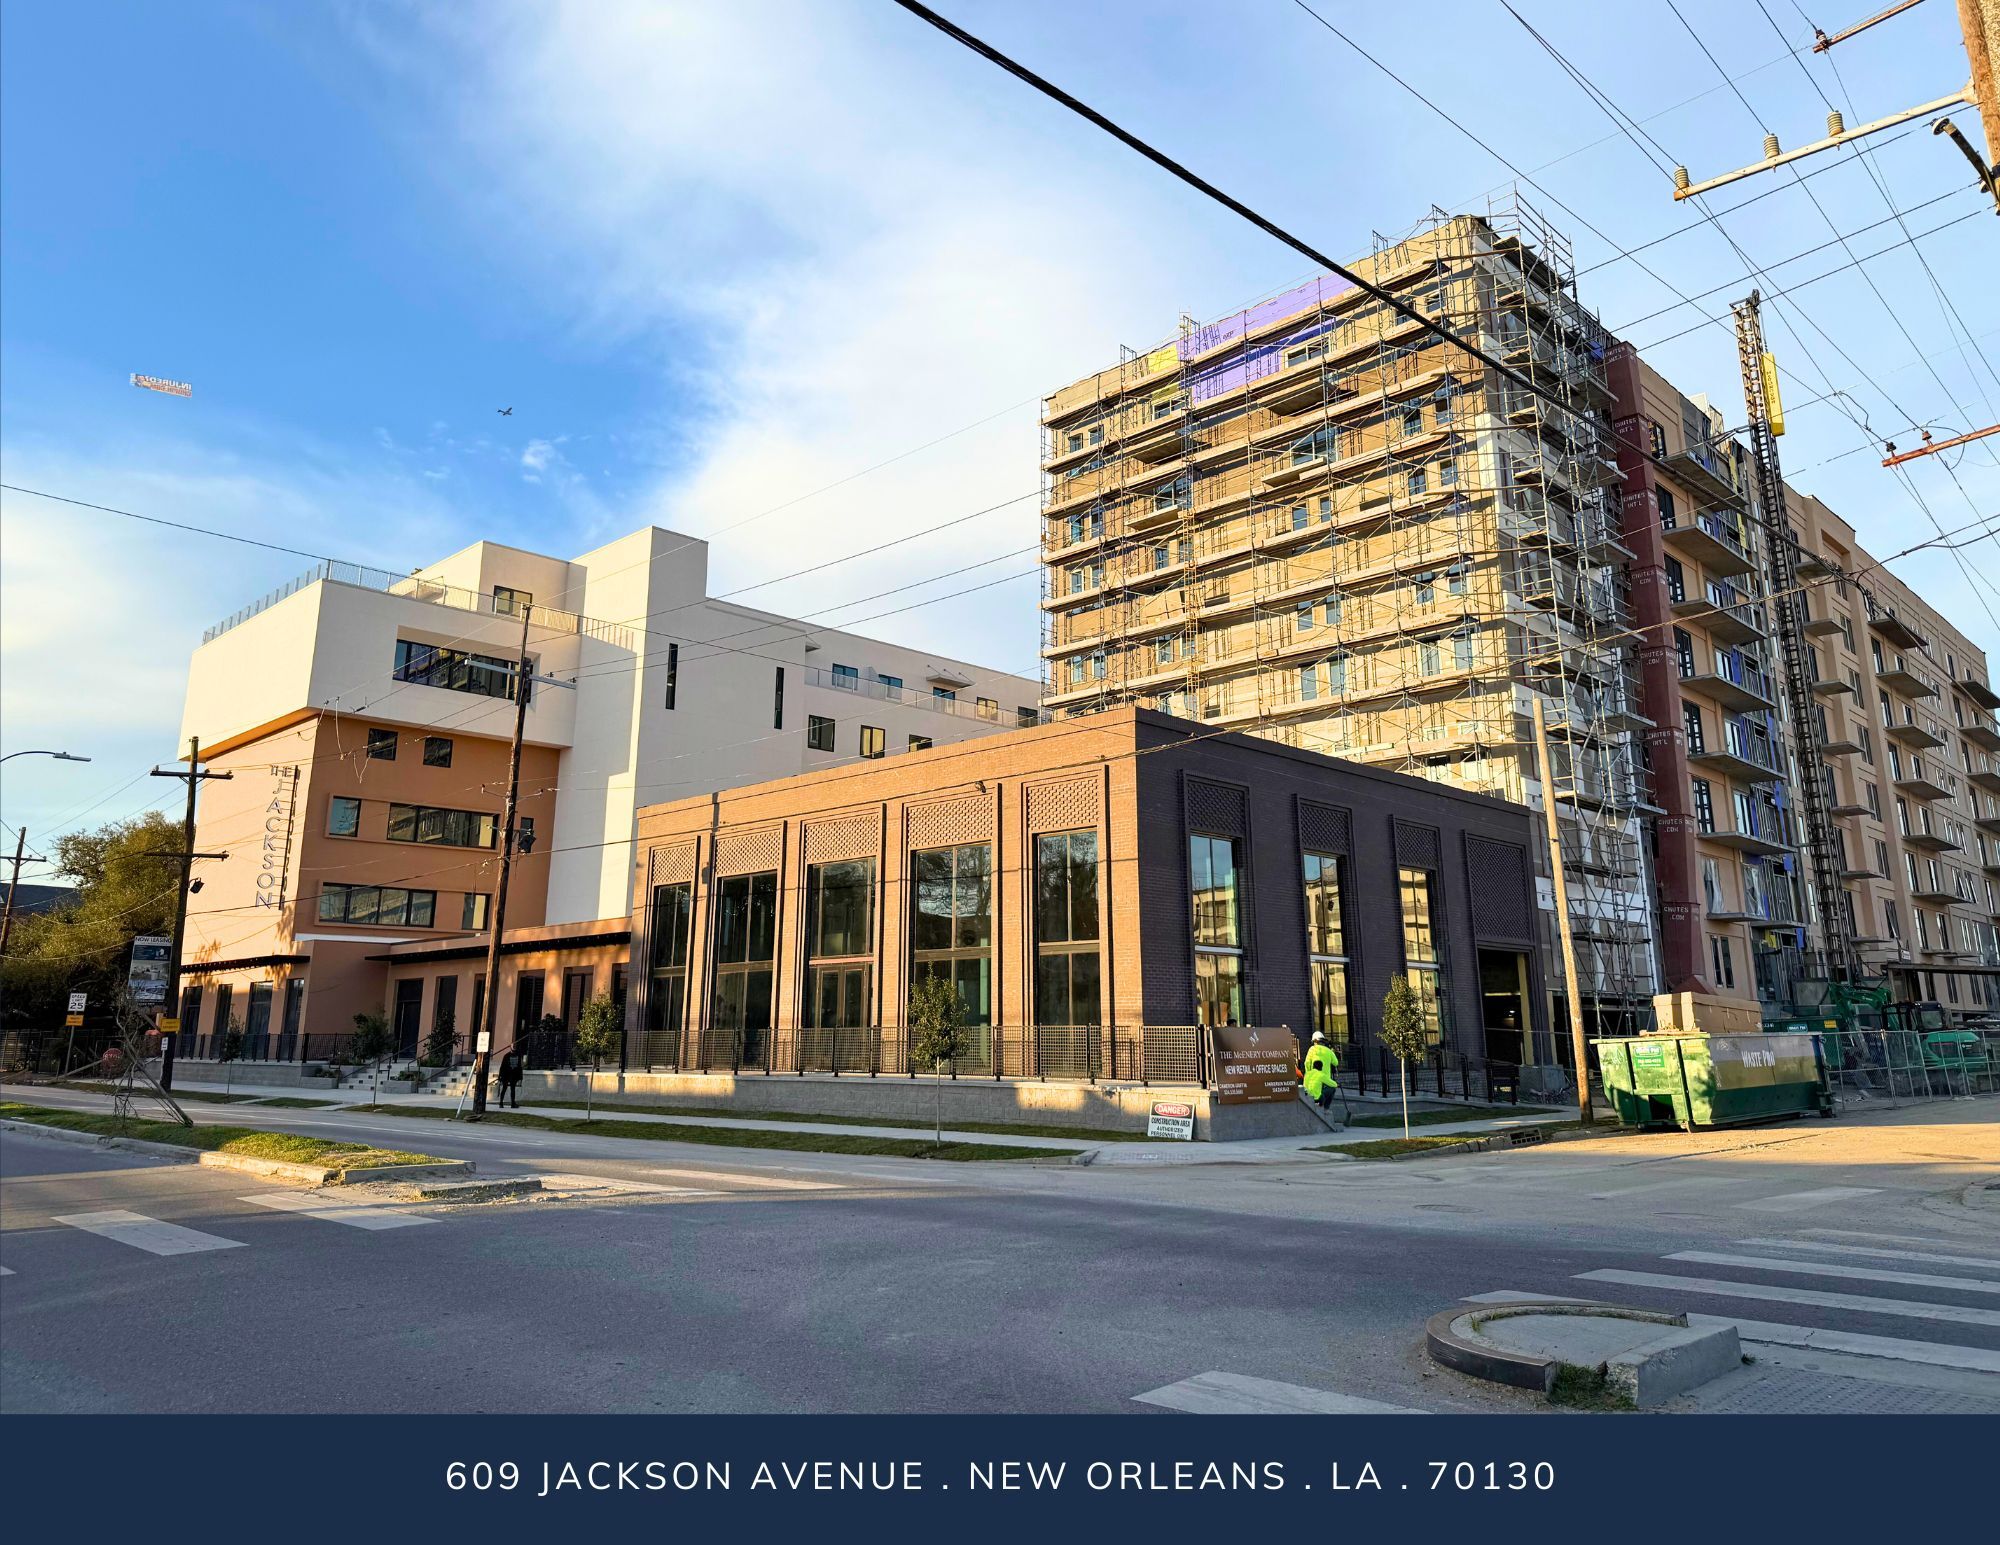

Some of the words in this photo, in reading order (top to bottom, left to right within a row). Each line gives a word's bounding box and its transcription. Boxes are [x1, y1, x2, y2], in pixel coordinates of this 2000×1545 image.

[1615, 417, 1637, 428] CHUTES
[1624, 492, 1645, 502] CHUTES
[1640, 650, 1663, 659] CHUTES
[1648, 730, 1670, 738] CHUTES
[270, 765, 293, 777] THE
[254, 779, 283, 910] JACKSON
[1220, 1051, 1232, 1059] THE
[1233, 1050, 1261, 1059] McENERY
[1261, 1050, 1289, 1058] COMPANY
[1741, 1051, 1762, 1068] WASTE
[1762, 1050, 1775, 1067] PRO
[1225, 1065, 1235, 1075] NEW
[1235, 1065, 1252, 1074] RETAIL
[1256, 1064, 1271, 1074] OFFICE
[1271, 1064, 1287, 1073] SPACES
[1159, 1105, 1186, 1115] DANGER
[1151, 1117, 1180, 1126] CONSTRUCTION
